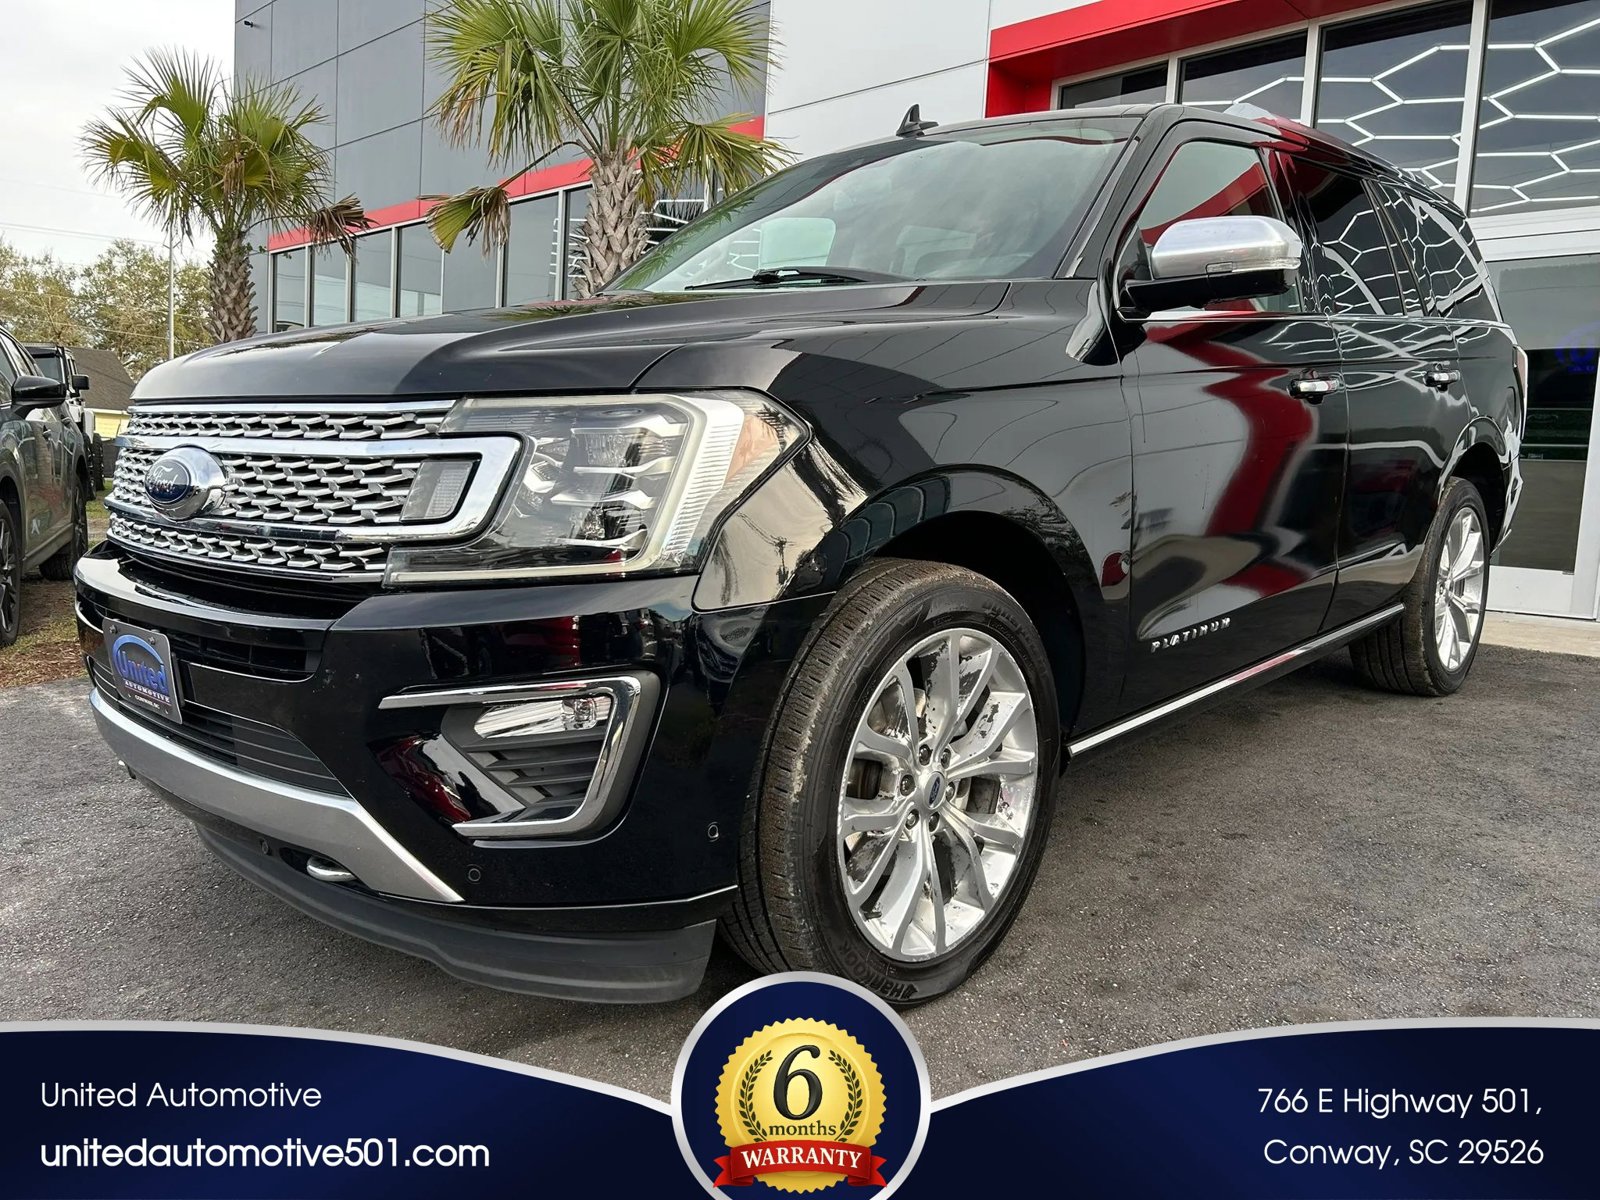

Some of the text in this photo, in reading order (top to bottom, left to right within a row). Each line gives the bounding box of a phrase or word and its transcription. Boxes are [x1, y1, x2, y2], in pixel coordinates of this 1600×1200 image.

[148, 465, 179, 494] Ford
[1151, 617, 1231, 653] PLATINUM
[116, 649, 170, 696] United
[124, 680, 171, 703] AUTOMOTIVE
